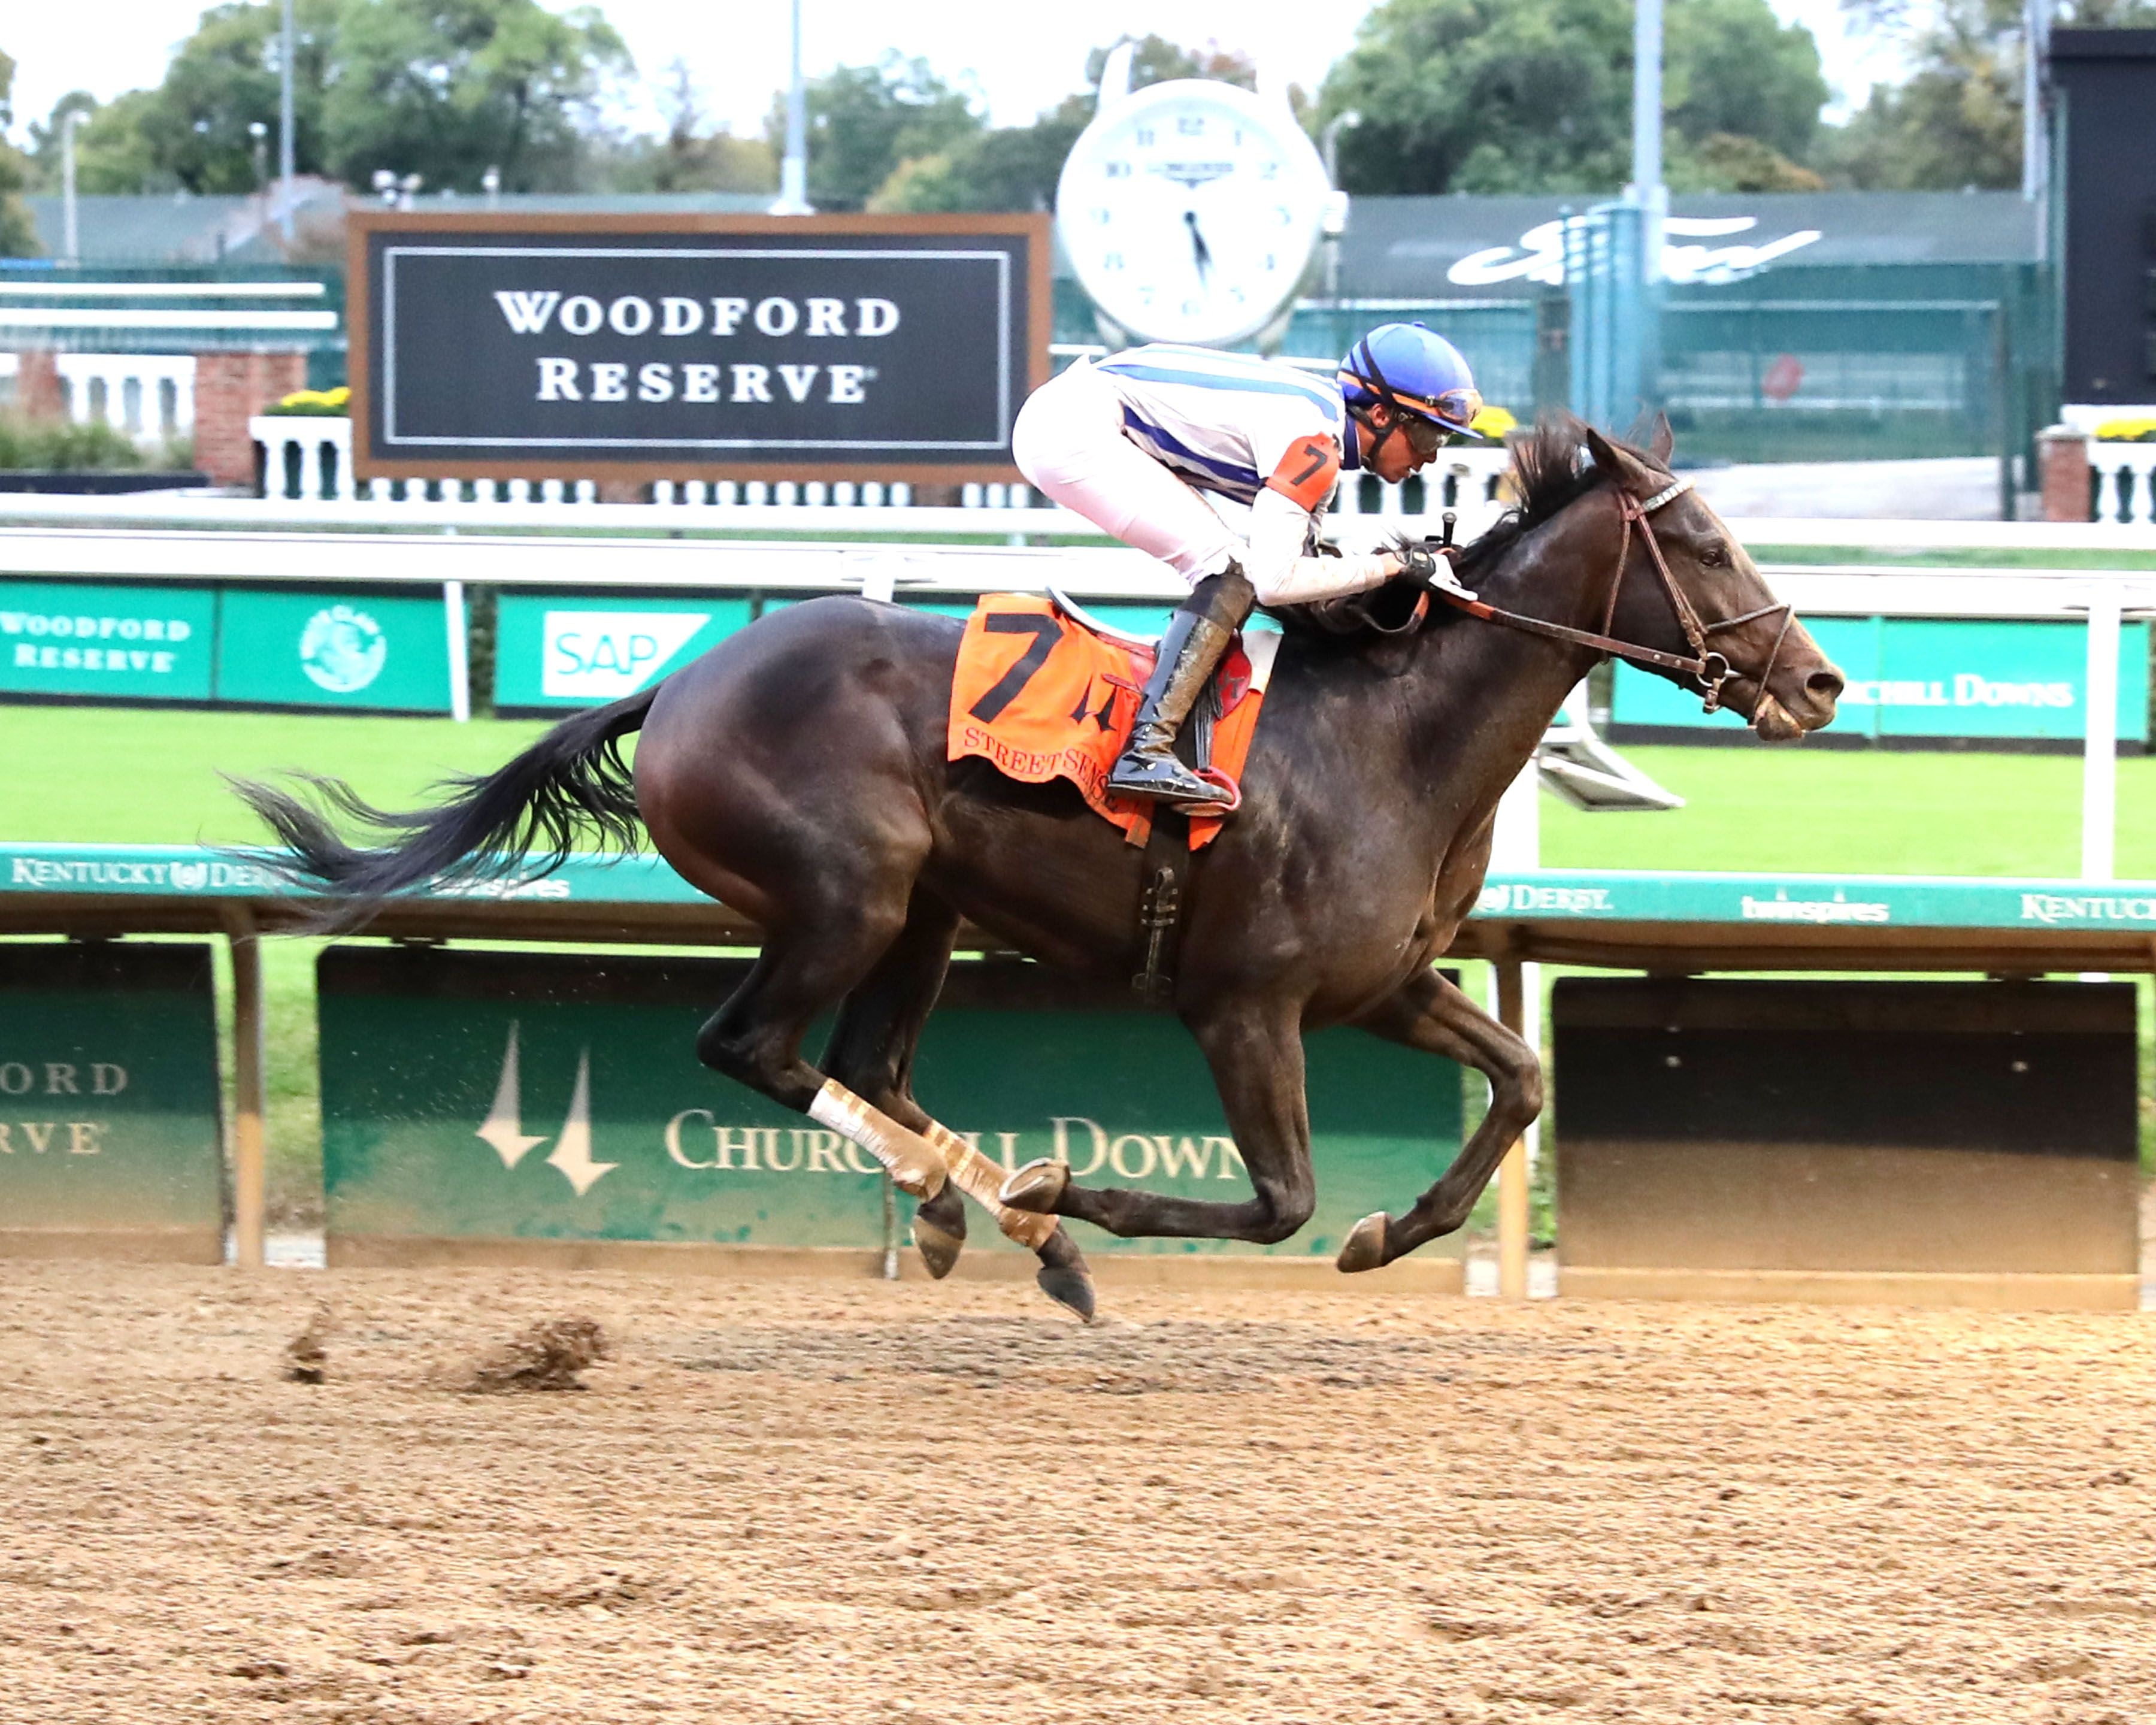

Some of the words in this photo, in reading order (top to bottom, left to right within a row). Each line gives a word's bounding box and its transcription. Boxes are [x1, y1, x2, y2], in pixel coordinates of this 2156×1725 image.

[495, 290, 900, 338] WOODFORD
[1292, 443, 1327, 486] 7
[0, 611, 191, 641] WOODFORD
[14, 643, 175, 673] RESERVE
[555, 632, 658, 676] SAP
[969, 613, 1064, 724] 7
[1953, 673, 2075, 707] DOWNS
[964, 727, 1062, 775] STREET
[11, 857, 169, 887] KENTUCKY
[2020, 894, 2156, 923] KENTUC
[664, 1109, 1020, 1174] CHURCL
[1050, 1116, 1248, 1179] DOWN
